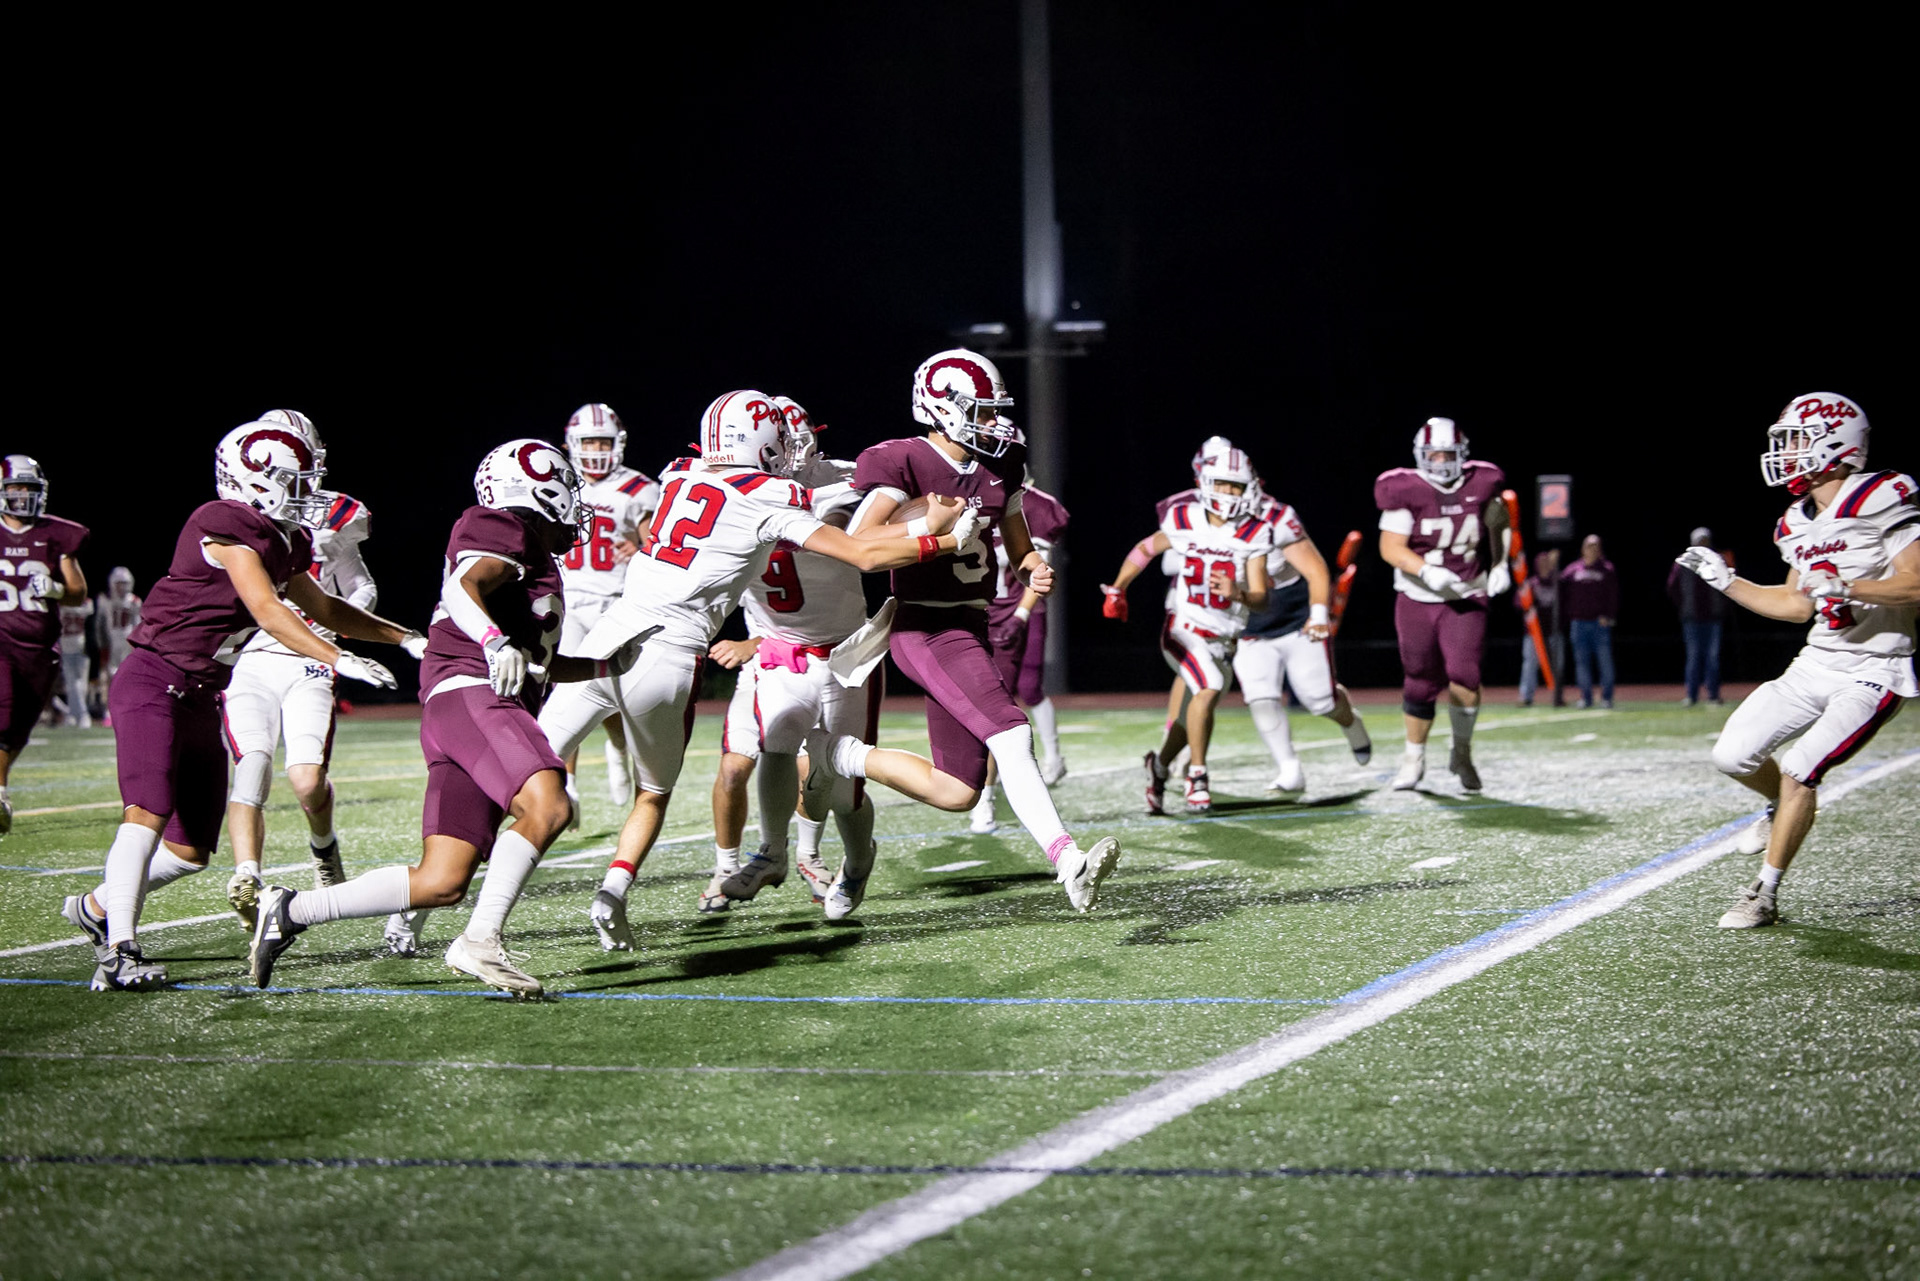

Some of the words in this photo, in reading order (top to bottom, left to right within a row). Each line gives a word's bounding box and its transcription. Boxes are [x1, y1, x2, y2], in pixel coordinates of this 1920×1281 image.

[1795, 398, 1858, 424] Pats
[640, 477, 728, 570] 12
[1541, 484, 1568, 518] 2
[1421, 514, 1480, 567] 74
[0, 559, 51, 613] 62
[761, 549, 805, 613] 9
